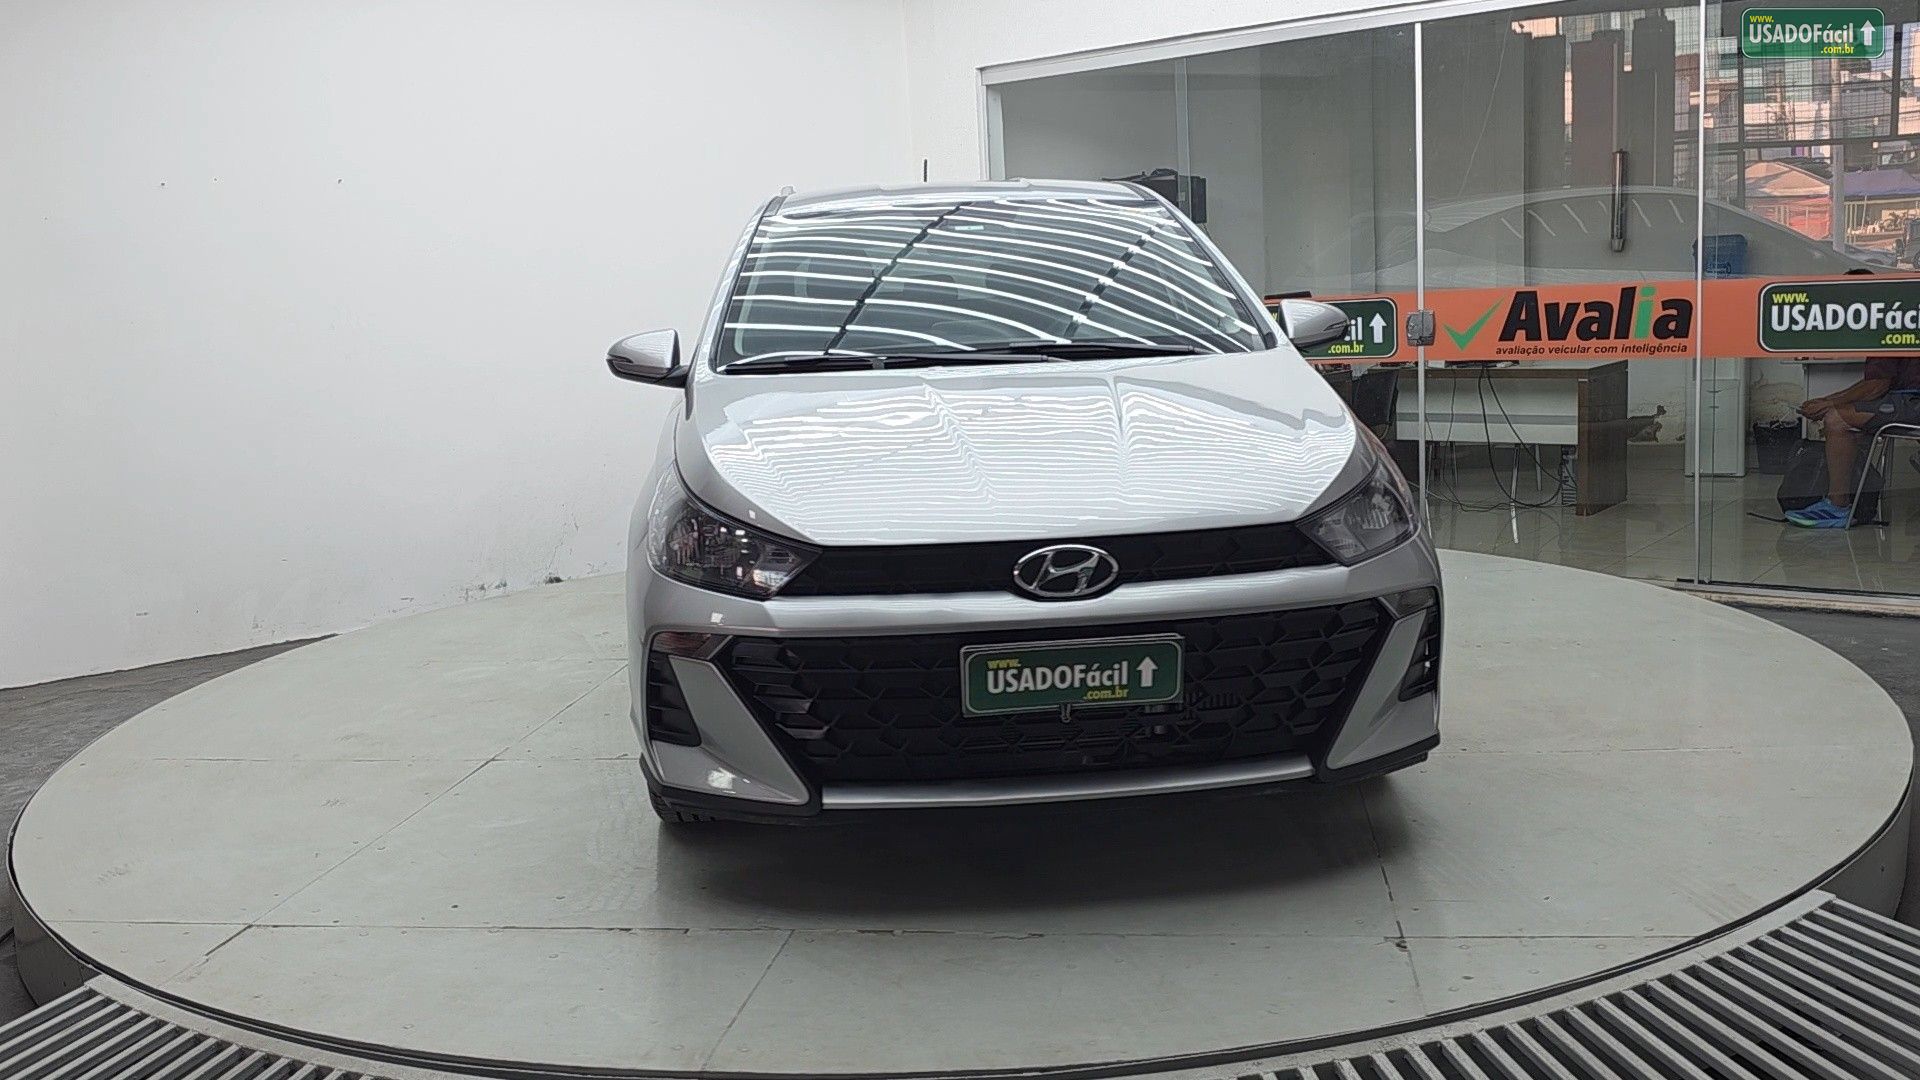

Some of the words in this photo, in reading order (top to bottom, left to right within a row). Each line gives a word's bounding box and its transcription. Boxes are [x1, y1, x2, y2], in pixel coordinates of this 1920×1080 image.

[1772, 292, 1810, 304] www.
[1498, 286, 1693, 342] Avalia
[1327, 341, 1365, 354] .com.br
[1496, 345, 1546, 357] avaliação
[1548, 344, 1592, 354] veicular
[1594, 345, 1618, 354] com
[1621, 342, 1688, 356] inteligência
[987, 660, 1129, 695] USADOFácil
[1083, 687, 1129, 700] .com.br
